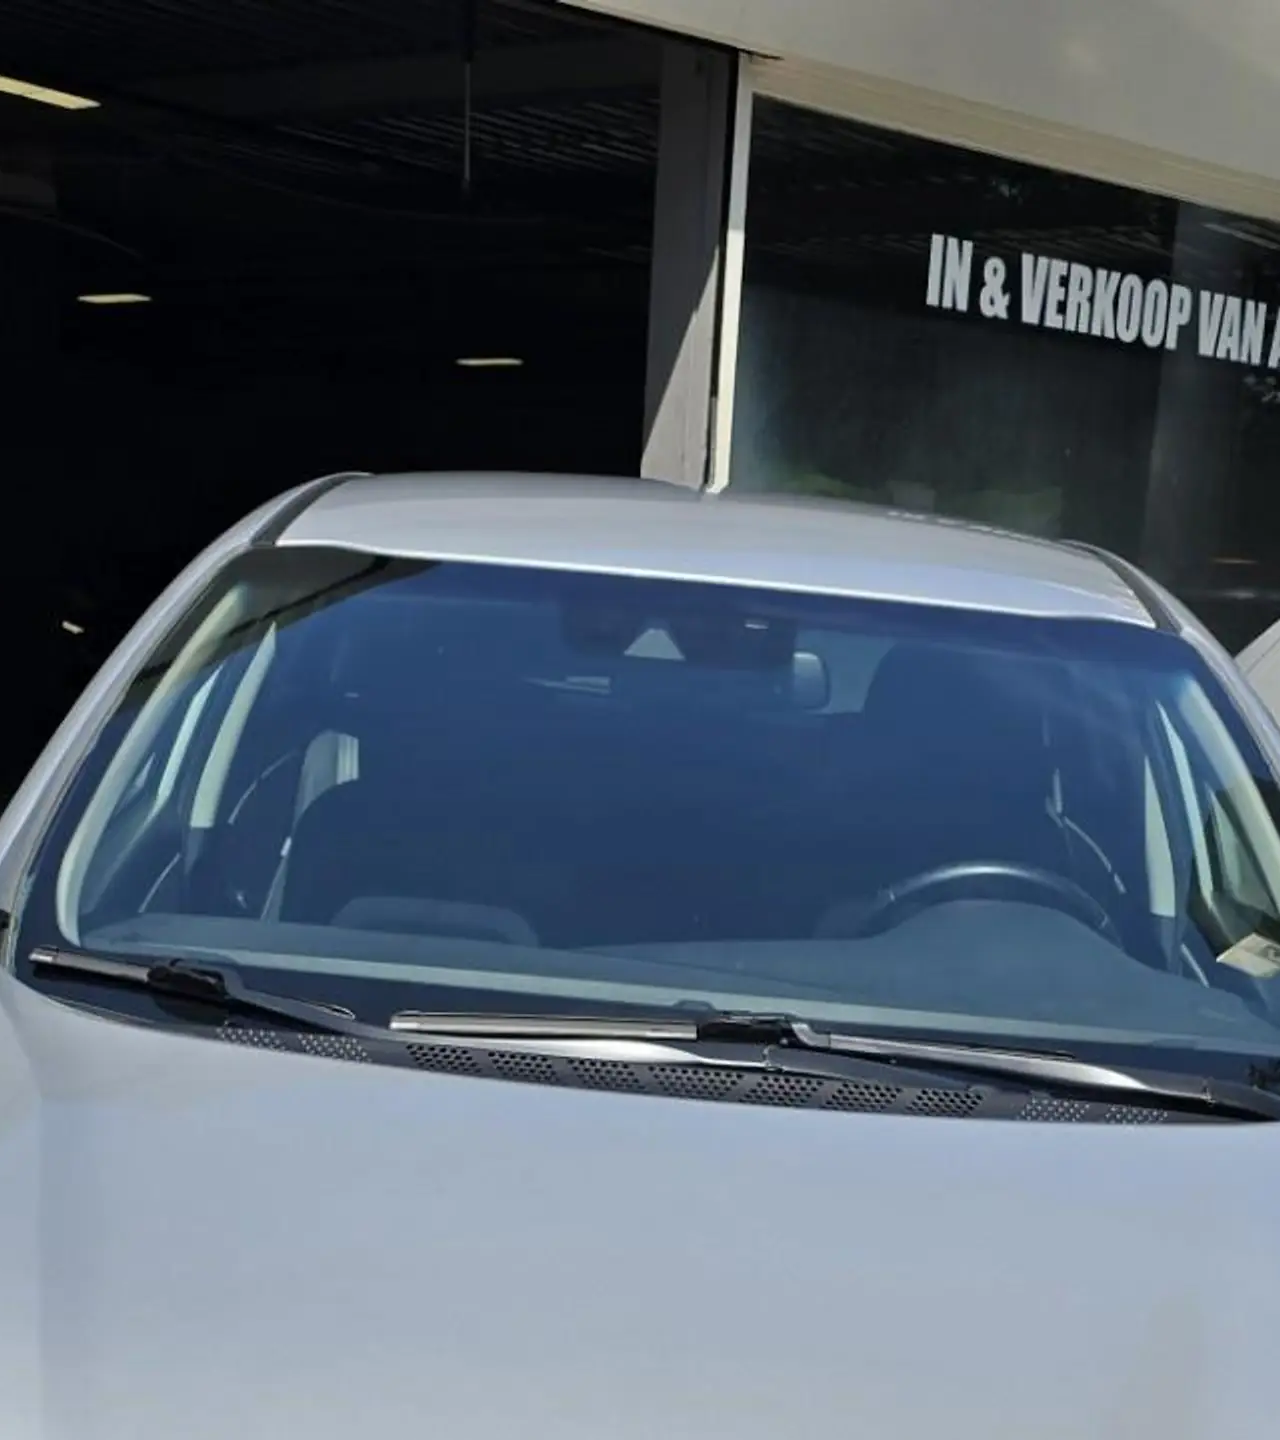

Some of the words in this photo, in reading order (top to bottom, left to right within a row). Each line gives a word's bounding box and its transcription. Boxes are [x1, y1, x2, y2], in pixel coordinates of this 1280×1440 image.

[926, 233, 974, 312] IN
[979, 256, 1010, 319] &
[1020, 252, 1193, 350] VERKOOP
[1198, 290, 1268, 367] VAN
